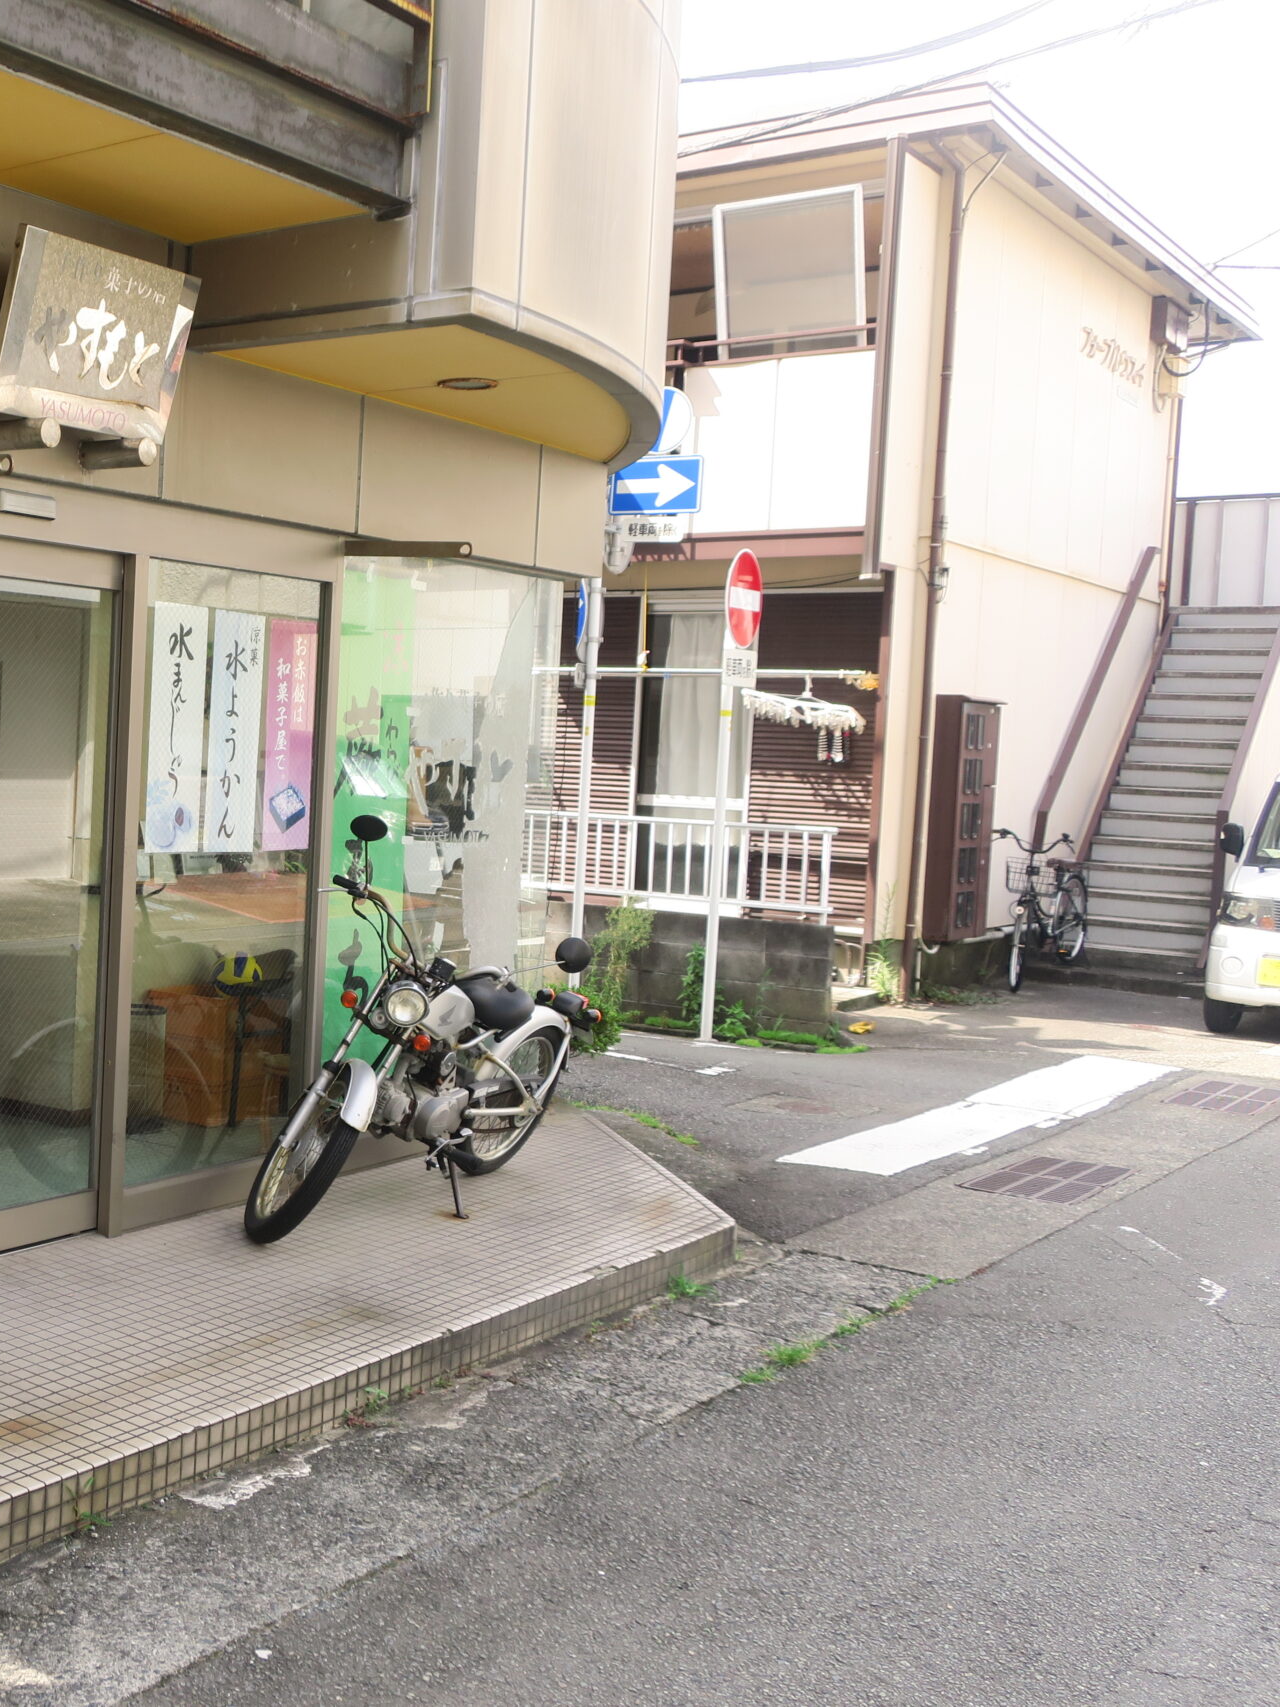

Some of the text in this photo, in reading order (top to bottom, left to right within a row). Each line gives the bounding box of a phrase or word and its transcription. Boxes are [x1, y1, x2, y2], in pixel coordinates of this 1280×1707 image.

[34, 298, 160, 390] やすもと
[41, 397, 126, 431] YASUMOTO
[167, 623, 195, 799] 水まんじゅう
[292, 638, 308, 724] お赤飯は
[218, 640, 248, 839] 水ようかん
